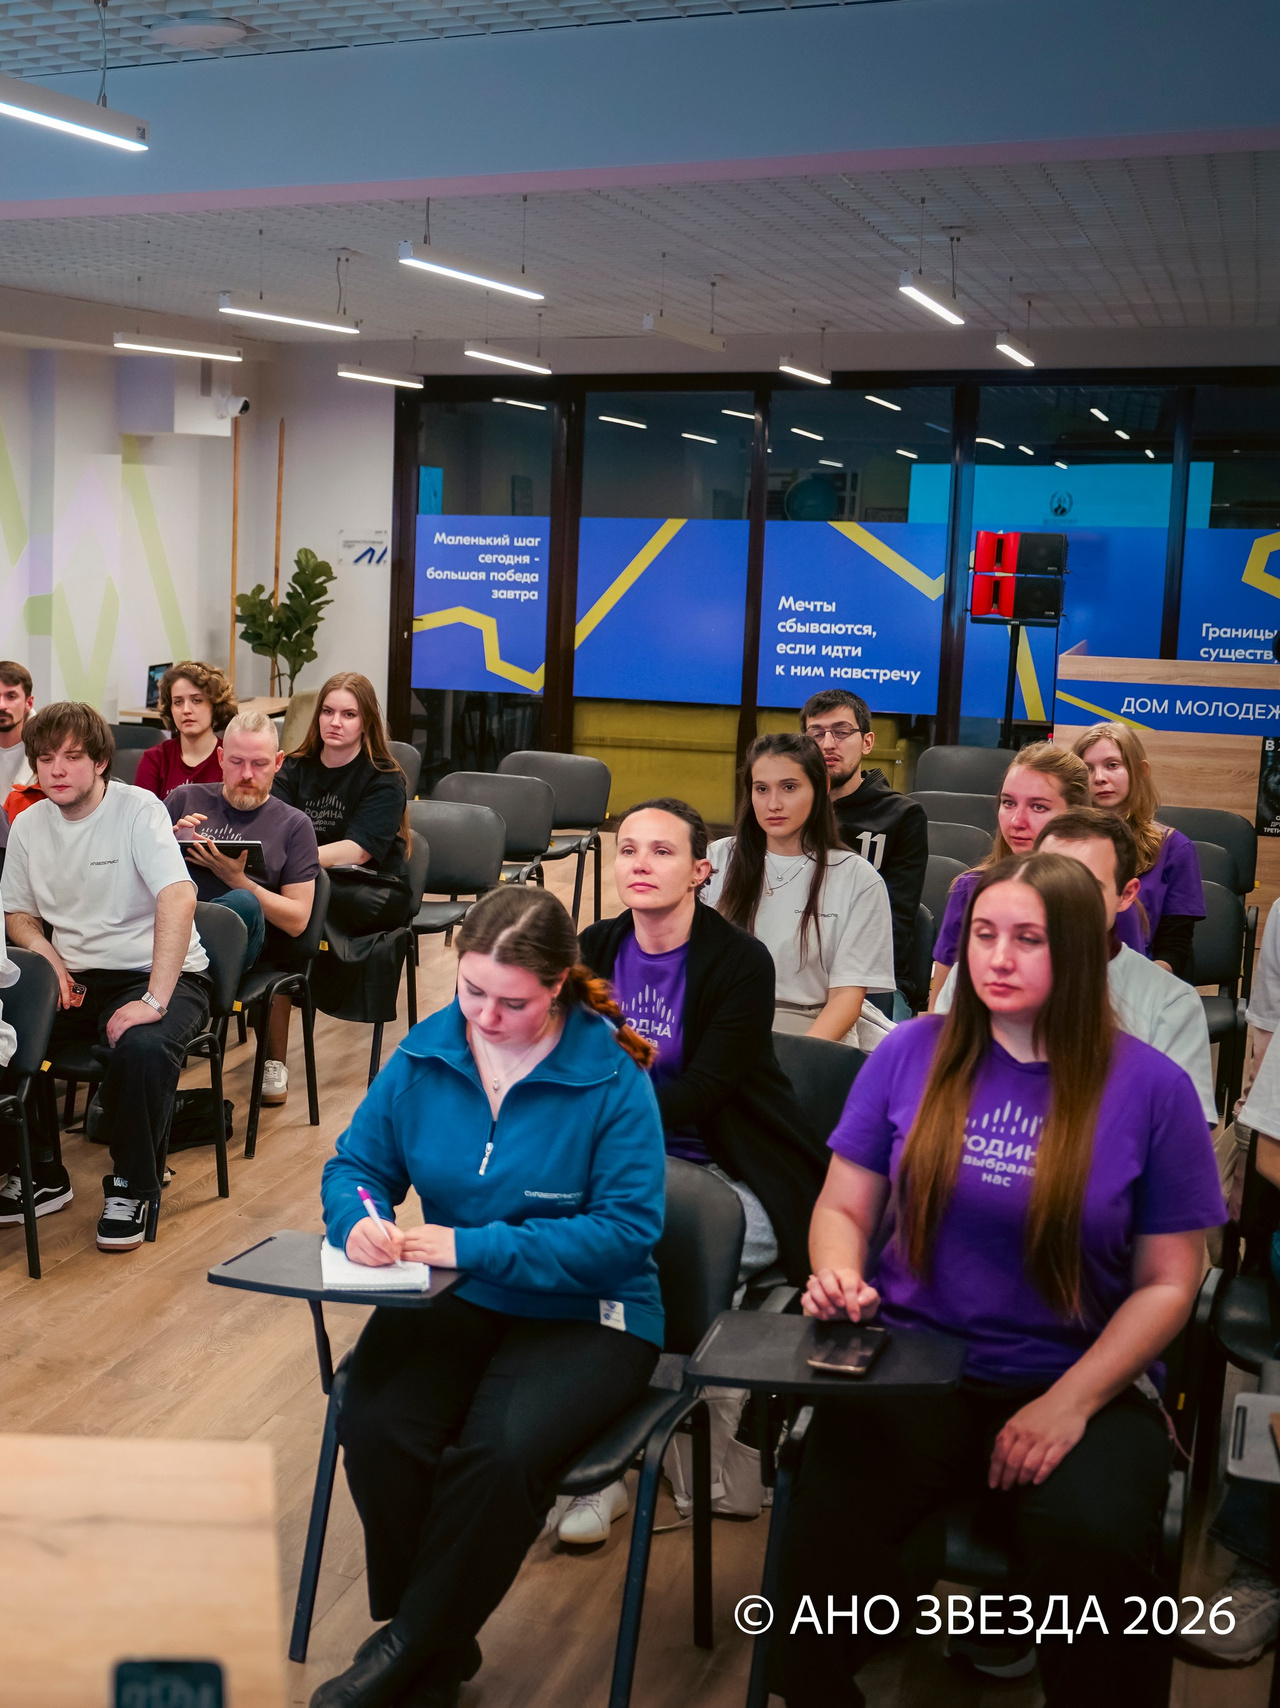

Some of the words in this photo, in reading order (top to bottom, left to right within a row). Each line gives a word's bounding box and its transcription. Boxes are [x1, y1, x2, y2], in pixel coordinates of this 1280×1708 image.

[433, 532, 510, 546] Маленький
[513, 537, 541, 547] шаг
[478, 553, 530, 565] сегодня
[426, 566, 486, 581] большая
[489, 568, 539, 584] победа
[491, 589, 539, 602] завтра
[778, 595, 836, 613] Мечты
[777, 618, 877, 639] сбываются,
[1201, 623, 1278, 641] Границы
[776, 642, 816, 655] если
[821, 645, 862, 659] идти
[1200, 647, 1278, 664] существ
[775, 664, 786, 676] к
[790, 664, 825, 678] ним
[830, 666, 921, 686] навстречу
[1120, 697, 1169, 715] ДОМ
[963, 1134, 1037, 1162] ОДИН
[981, 1172, 1012, 1188] нас
